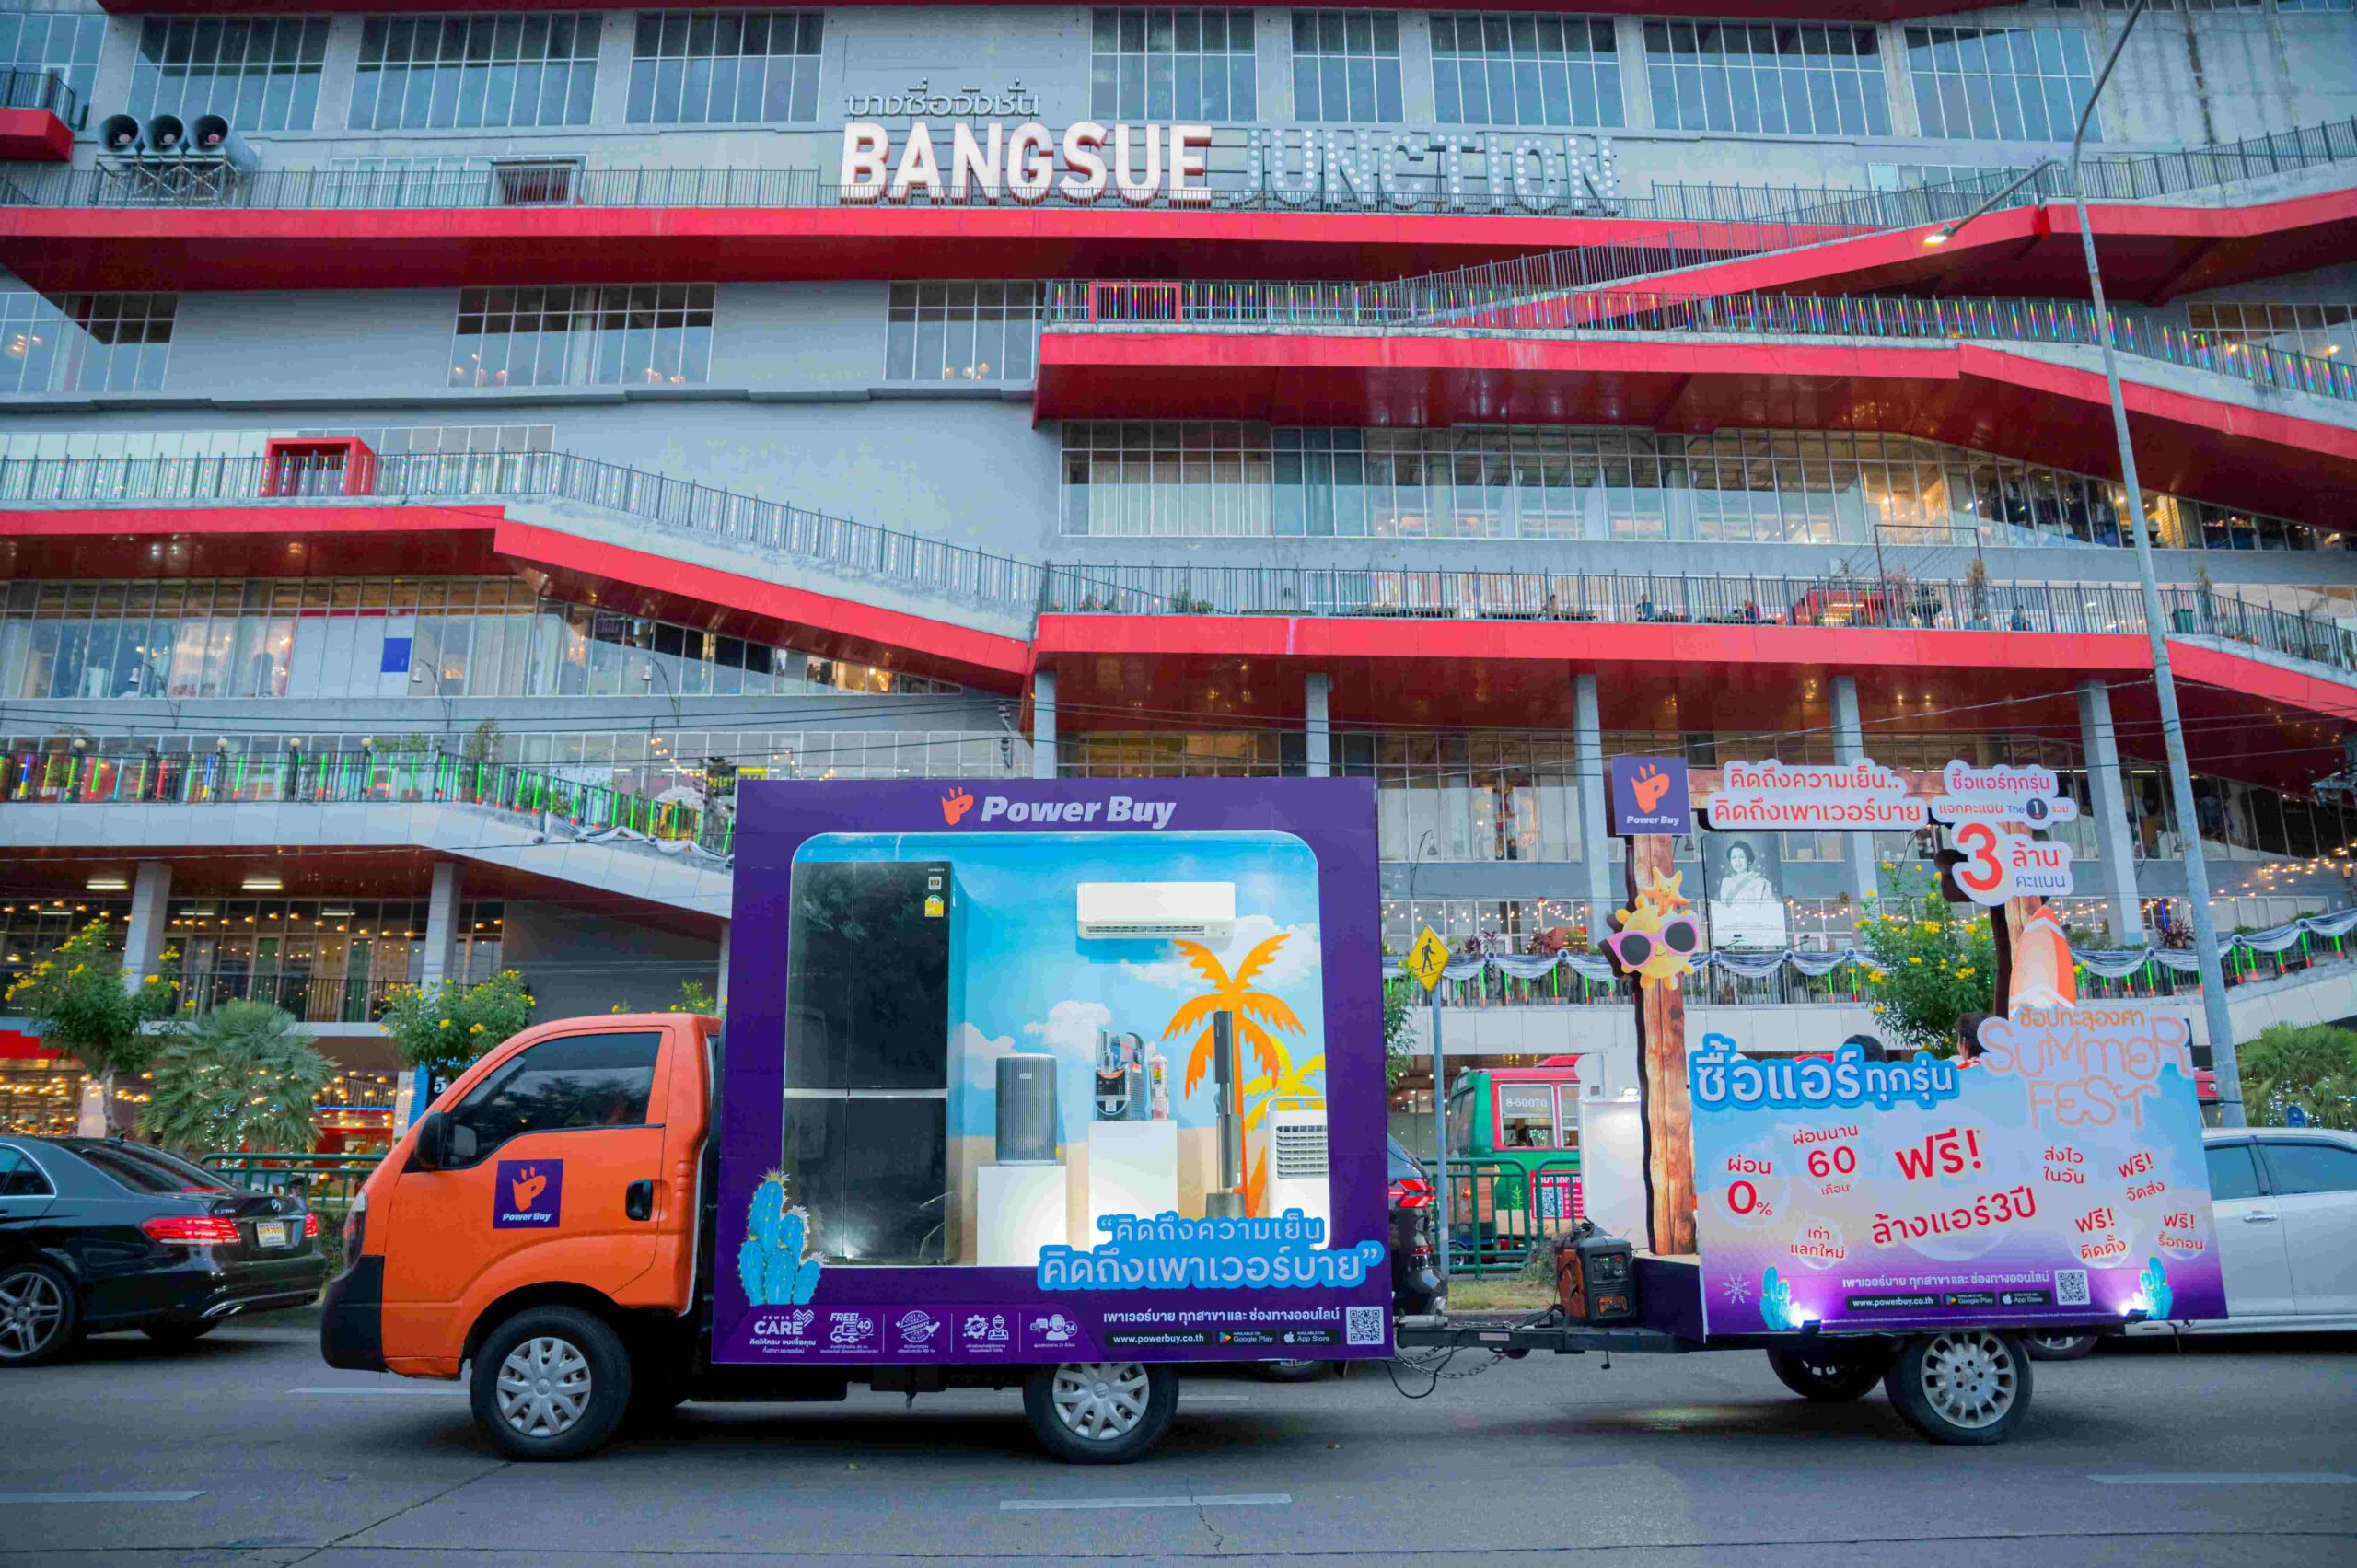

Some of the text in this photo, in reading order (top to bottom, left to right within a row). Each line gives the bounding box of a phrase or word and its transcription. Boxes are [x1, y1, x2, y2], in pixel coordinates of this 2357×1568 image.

[840, 121, 1619, 216] BANGSUE JUNCTION
[1951, 768, 2050, 796] ซื้อแอร์ทุกรุ่น
[981, 796, 1177, 830] Power Buy
[1714, 797, 1922, 822] คิดถึงเพาเวอร์บาย
[1939, 803, 2003, 815] แจกคะแนน
[2006, 805, 2025, 814] The
[2051, 805, 2069, 813] รวม
[1626, 815, 1679, 826] Power Buy
[1957, 821, 2003, 891] 3
[2015, 876, 2065, 888] คะแนน
[1695, 1040, 1953, 1102] ซื้อแอร์ทุกรุ่น
[1792, 1124, 1858, 1145] ผ่อนนาน
[1727, 1154, 1771, 1175] ผ่อน
[1807, 1145, 1856, 1179] 60
[2044, 1146, 2084, 1164] ส่งไว
[2117, 1152, 2154, 1179] ฟรี!
[2043, 1166, 2084, 1185] ในวัน
[1727, 1179, 1773, 1216] 0%
[2126, 1179, 2166, 1202] จัดส่ง
[502, 1213, 552, 1223] Power Buy
[1872, 1185, 2037, 1244] ล้างแอร์3ปี
[2074, 1207, 2116, 1234] ฟรี!
[2164, 1212, 2196, 1230] ฟรี!
[1808, 1225, 1830, 1240] เก่า
[2157, 1230, 2204, 1250] รื้อถอน
[1790, 1243, 1845, 1260] แลกใหม่
[2080, 1235, 2127, 1260] ติดตั้ง
[1842, 1275, 1906, 1288] เพาเวอร์บาย
[1909, 1274, 1950, 1289] ทุกสาขา
[1970, 1270, 2049, 1284] ช่องทางออนไลน์
[1852, 1296, 1933, 1307] www.powerbuy.co.th
[830, 1312, 859, 1321] FREE!
[857, 1320, 871, 1330] 40
[1103, 1307, 1341, 1326] เพาเวอร์บาย ทุกสาขา และ ช่องทางออนไลน์
[754, 1320, 804, 1335] CARE
[1065, 1324, 1075, 1332] 24
[1112, 1333, 1205, 1345] www.powerbuy.co.th
[1233, 1335, 1273, 1343] Google Play
